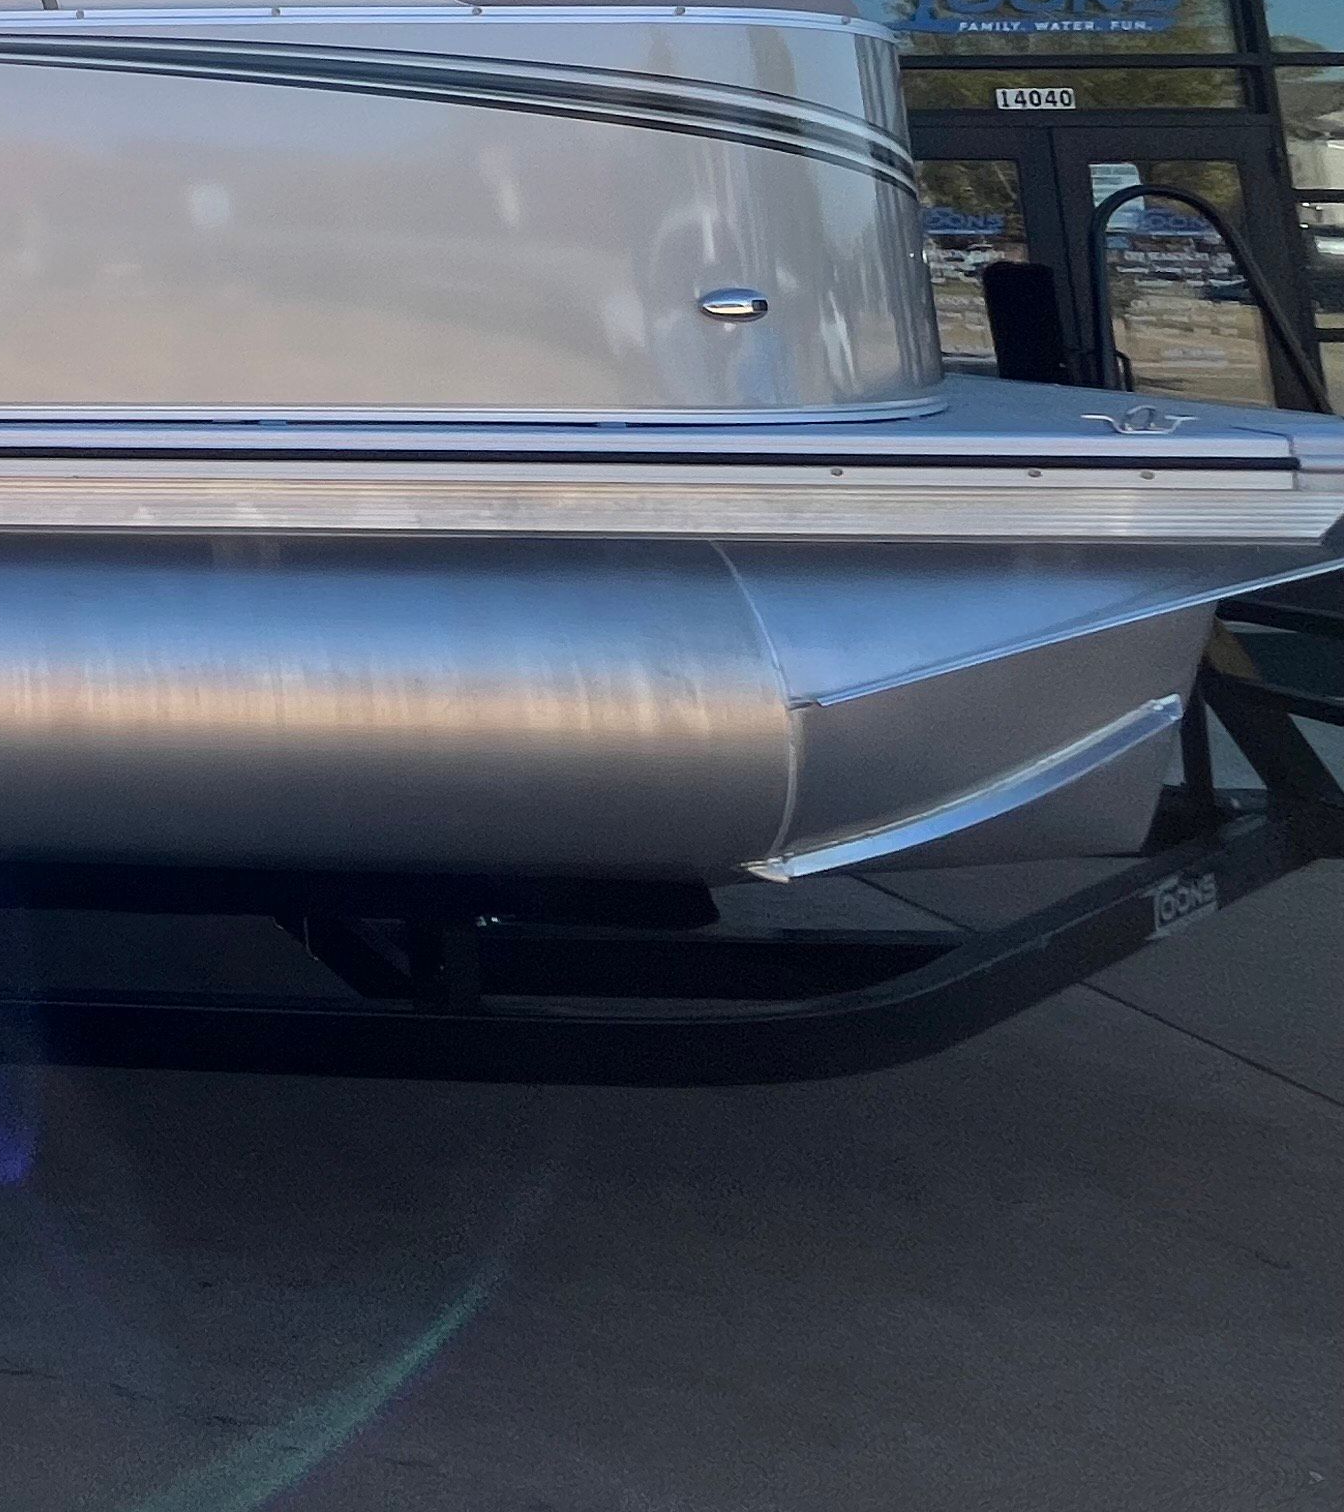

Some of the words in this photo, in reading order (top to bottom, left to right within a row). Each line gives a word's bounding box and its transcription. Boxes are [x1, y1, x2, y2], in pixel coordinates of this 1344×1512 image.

[959, 21, 1026, 32] FAMILY.
[1035, 21, 1101, 32] WATER.
[1110, 20, 1152, 32] FUN.
[1002, 90, 1072, 107] 14040
